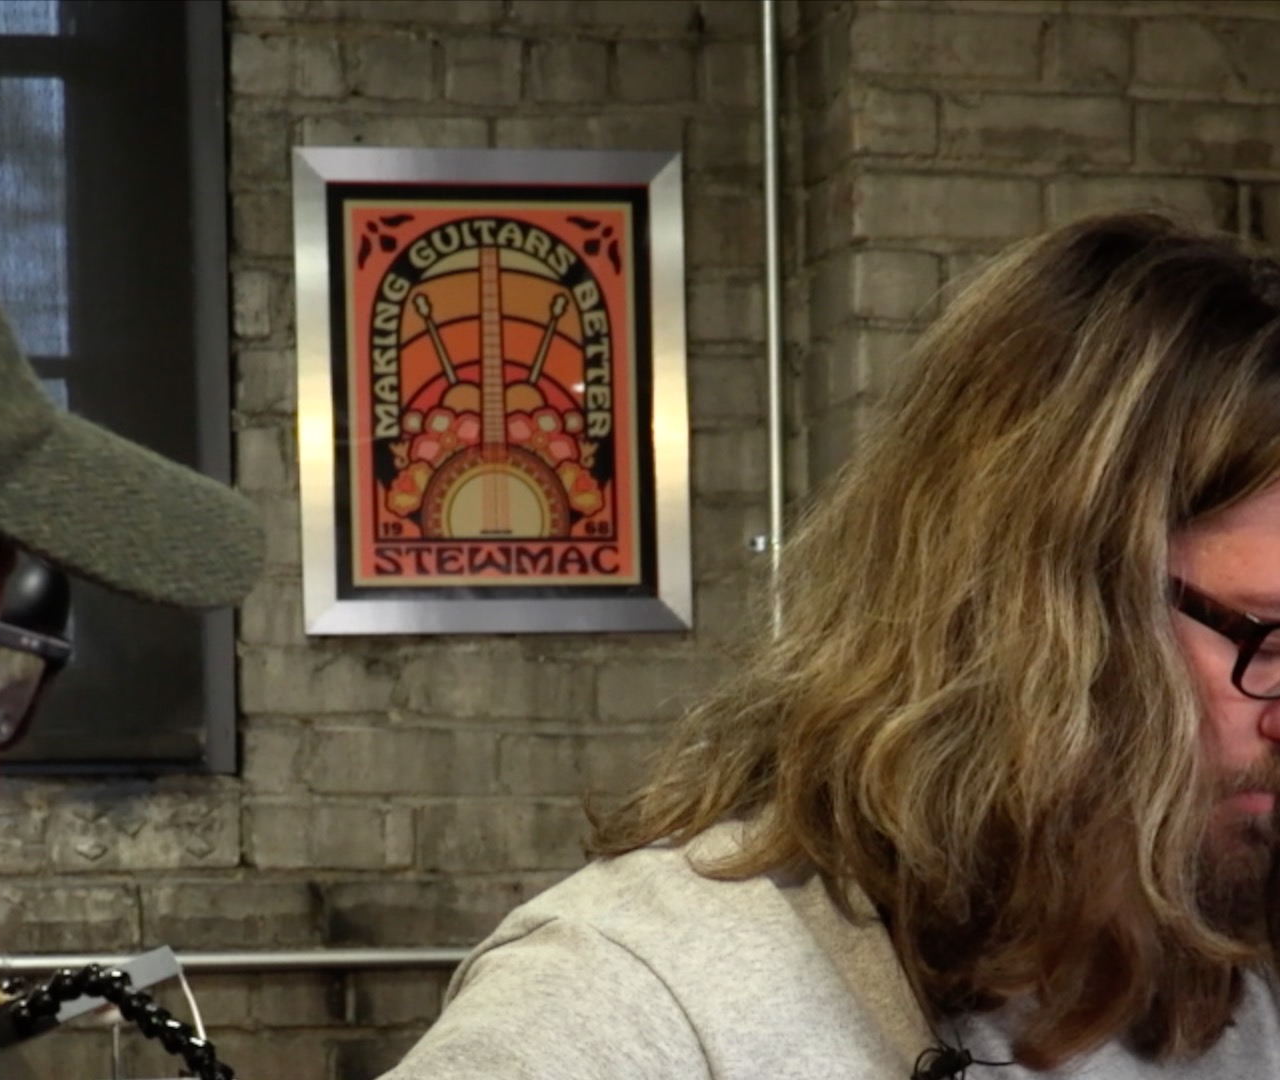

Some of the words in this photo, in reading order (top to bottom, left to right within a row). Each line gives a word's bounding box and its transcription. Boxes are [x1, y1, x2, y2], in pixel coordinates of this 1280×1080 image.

[372, 273, 410, 438] MAKING
[408, 219, 576, 275] GUITARS
[572, 279, 612, 437] BETTER
[382, 521, 403, 536] 19
[584, 520, 610, 535] 68
[373, 545, 620, 576] STEWMAC
